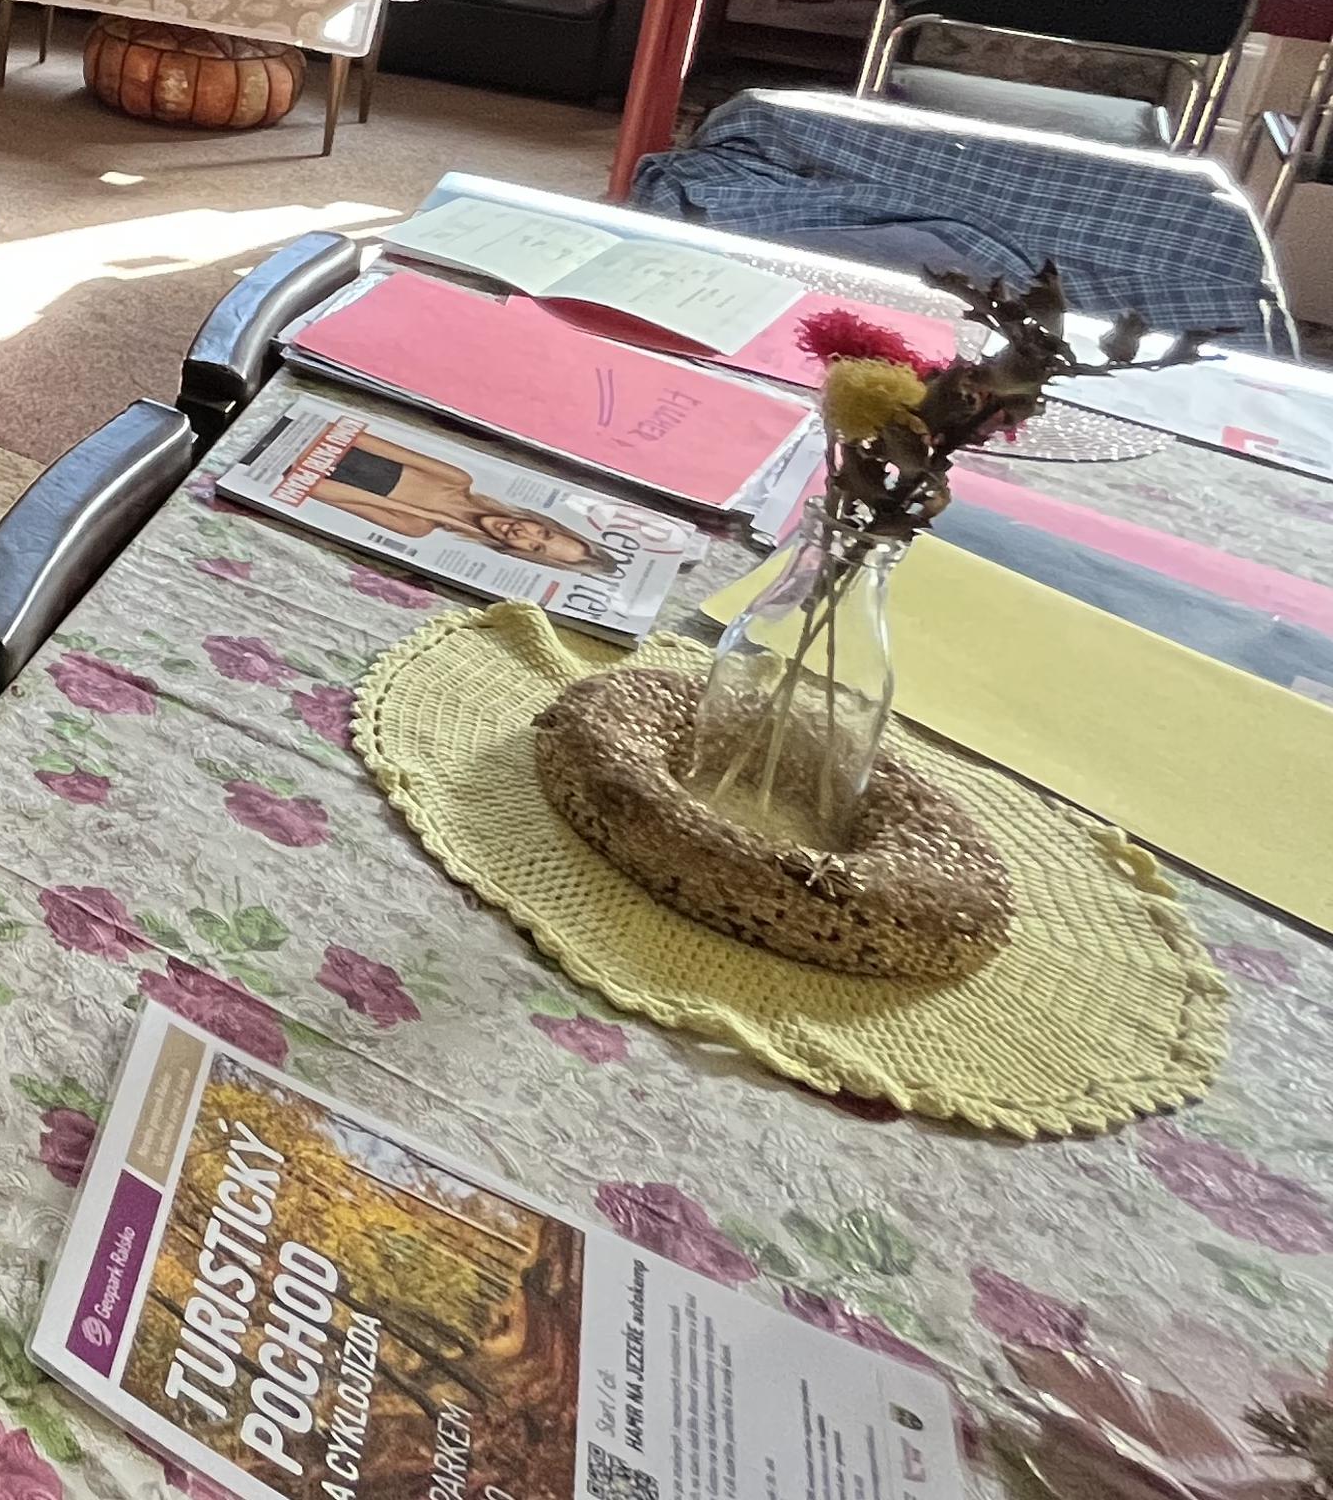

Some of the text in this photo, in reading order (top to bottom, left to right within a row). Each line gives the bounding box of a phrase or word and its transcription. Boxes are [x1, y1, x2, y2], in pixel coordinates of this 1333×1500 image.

[272, 467, 321, 504] PRAHA
[325, 417, 365, 447] KOMU
[94, 1226, 136, 1319] Geopark Ralsko
[164, 1117, 285, 1420] TURISTICKÝ
[240, 1240, 339, 1477] POCHOD
[325, 1311, 382, 1481] CYKLOJÍZDA
[595, 1399, 617, 1439] Start
[622, 1258, 650, 1455] HAMR NA JEZEŘE autokemp
